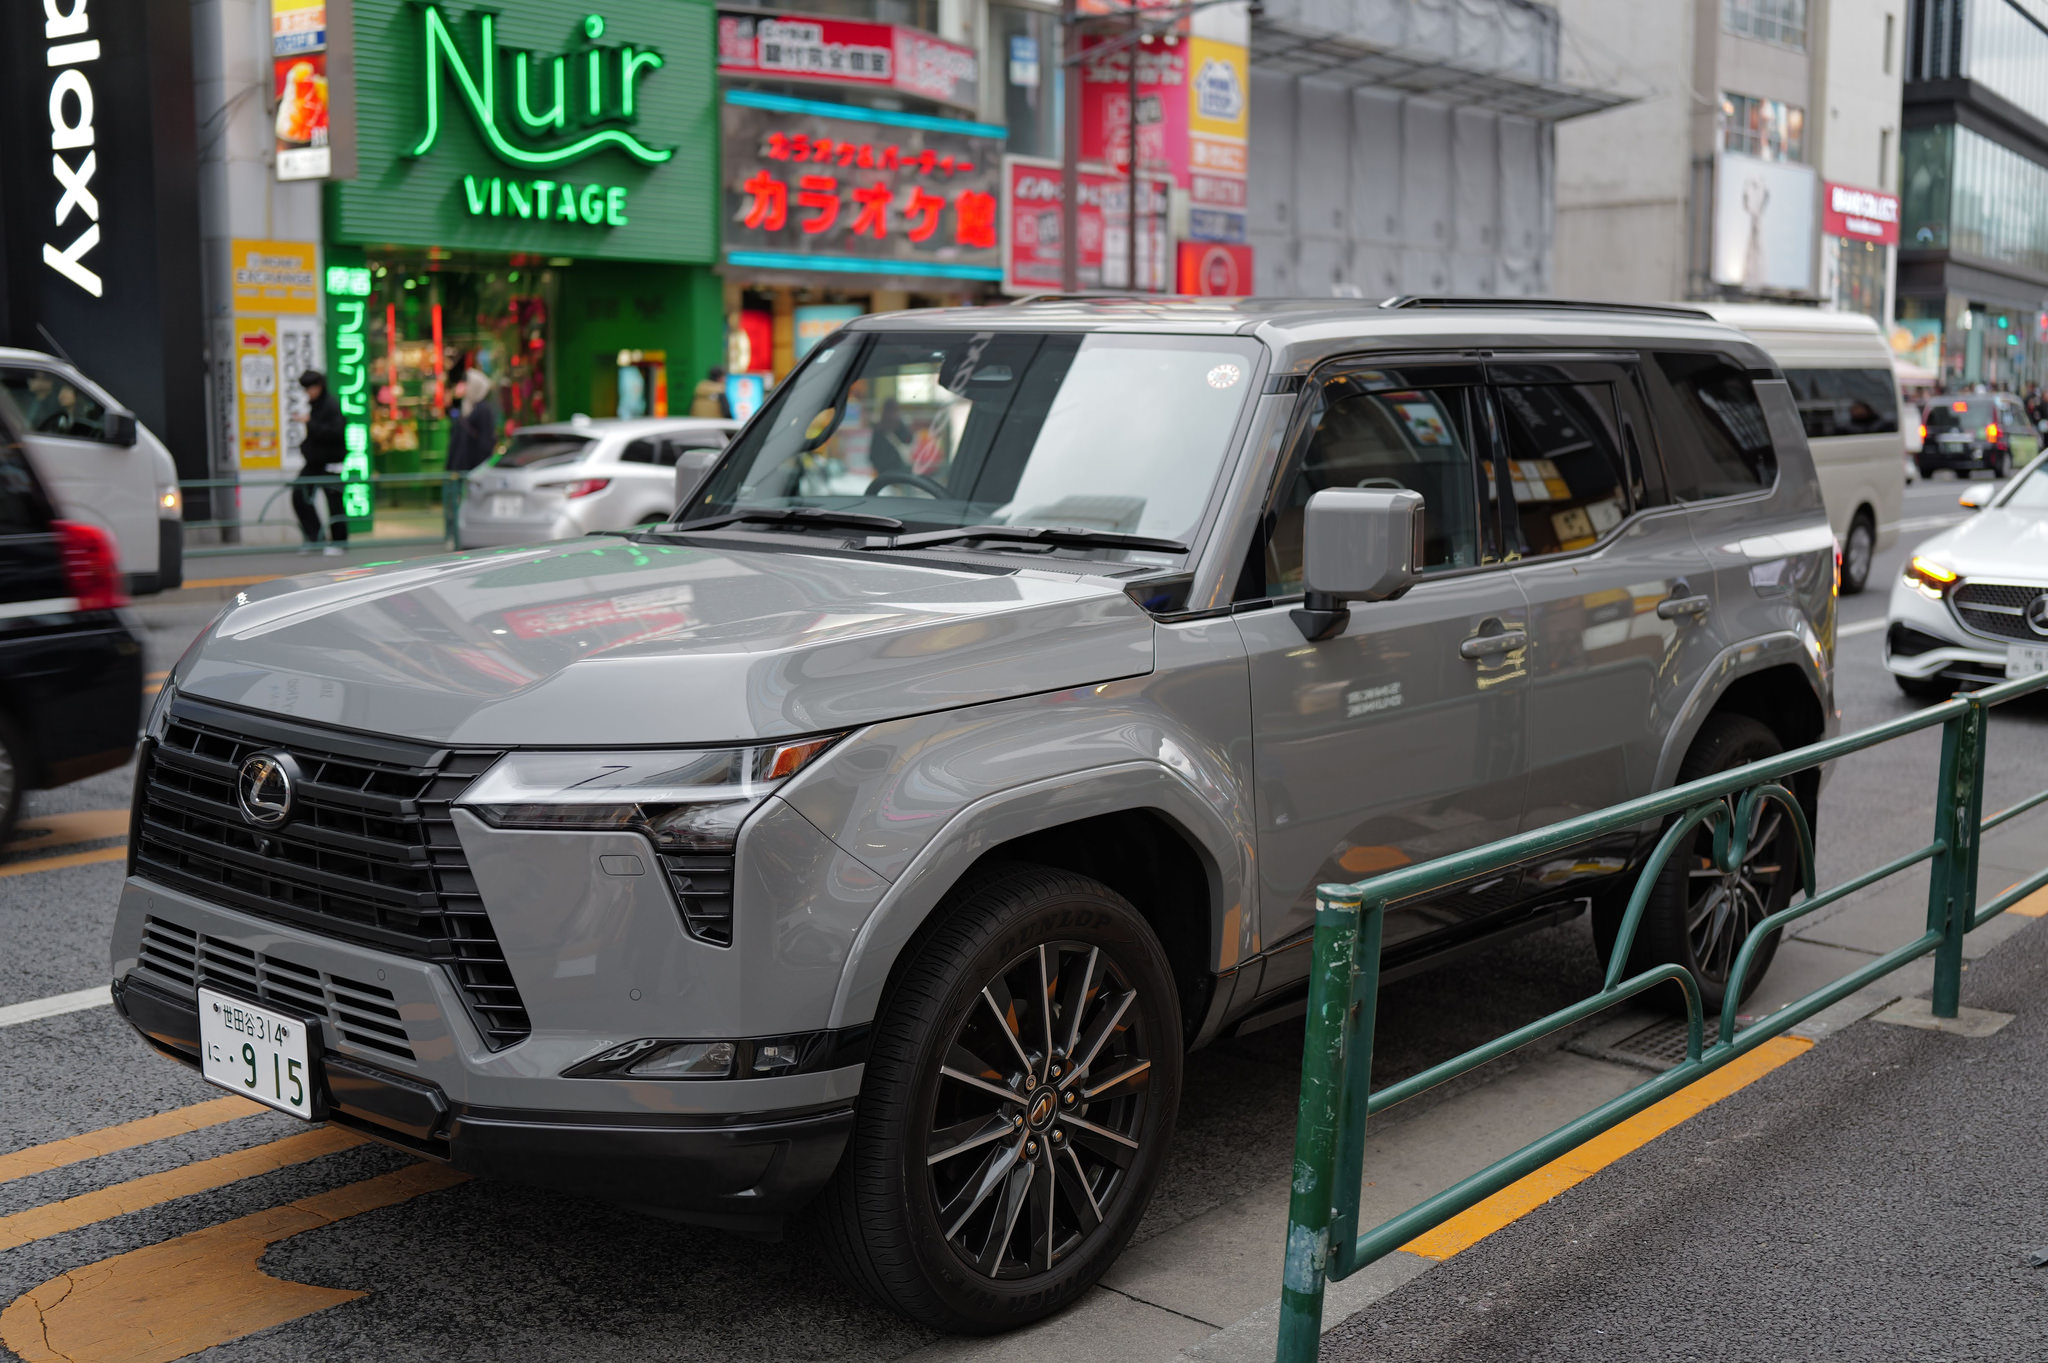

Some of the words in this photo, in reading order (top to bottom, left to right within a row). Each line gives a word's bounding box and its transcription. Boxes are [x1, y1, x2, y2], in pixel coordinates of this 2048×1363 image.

[413, 6, 672, 162] Nuir
[464, 174, 629, 226] VINTAGE
[743, 169, 997, 248] カラオケ館
[237, 269, 312, 285] EXCHANGE
[1002, 910, 1113, 959] DUNLOP
